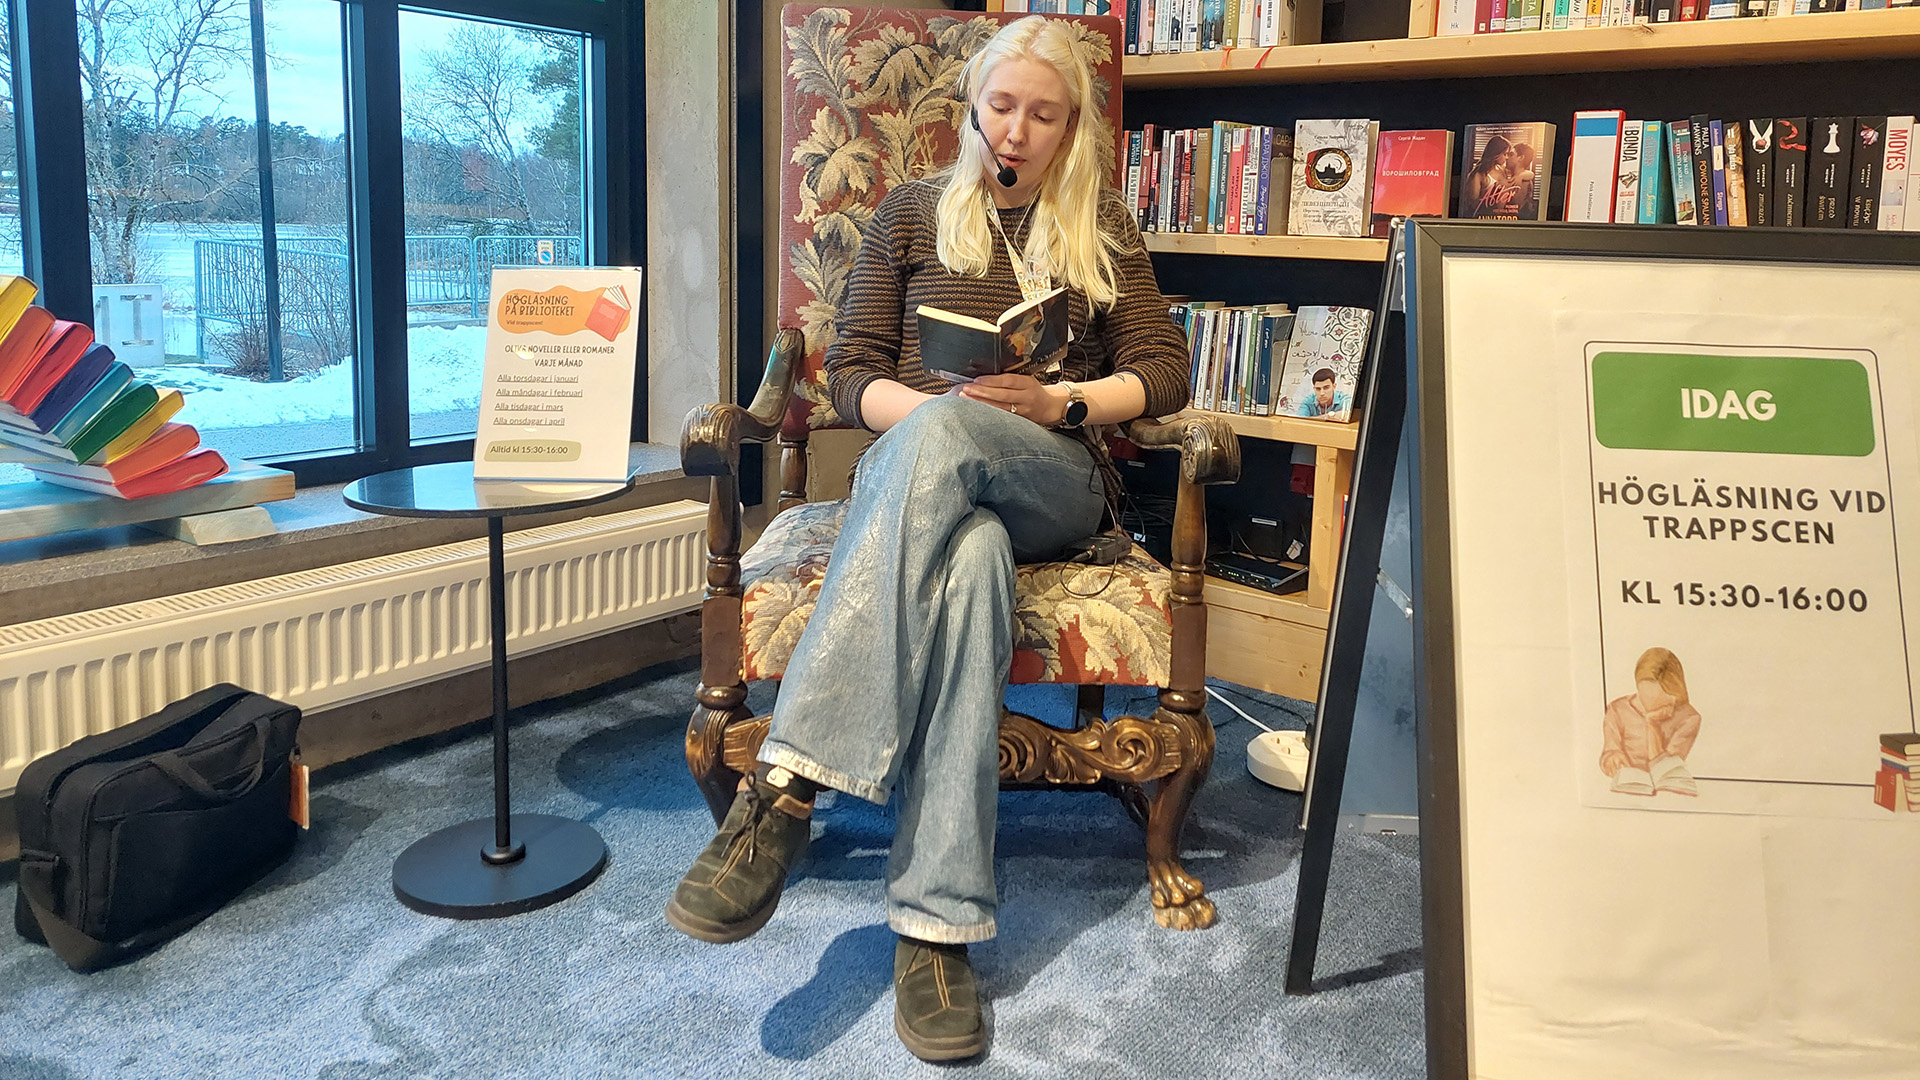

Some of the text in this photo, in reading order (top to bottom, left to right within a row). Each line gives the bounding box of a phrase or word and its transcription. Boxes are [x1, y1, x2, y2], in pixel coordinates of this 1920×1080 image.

[1622, 129, 1639, 162] BONDA
[1693, 122, 1702, 155] HAWKINS
[1886, 129, 1908, 171] MOYES
[1473, 184, 1521, 217] After
[1699, 160, 1710, 225] POWOLNE SPALANI
[505, 292, 569, 306] HÖGLÄSNING
[504, 304, 575, 317] PÅ BIBLIOTEKET
[528, 345, 562, 354] NOVELLER
[562, 345, 581, 354] ELLER
[582, 345, 615, 354] ROMANER
[534, 357, 583, 367] VARJE MÅNAD
[497, 374, 512, 382] Alla
[513, 374, 548, 384] torsdagar
[553, 375, 579, 384] januari
[496, 388, 510, 396] Alla
[513, 388, 548, 398] måndagar
[554, 388, 583, 397] februari
[494, 402, 509, 411] Alla
[511, 403, 540, 412] tisdagar
[1680, 387, 1777, 421] IDAG
[493, 417, 508, 425] Alla
[509, 417, 543, 426] onsdagar
[549, 417, 565, 426] april
[490, 445, 510, 453] Alltid
[521, 446, 568, 454] 15:30-16:00
[1598, 475, 1886, 513] HÖGLÄSNING VID
[1643, 515, 1835, 544] TRAPPSCEN
[1621, 580, 1868, 612] KL 15:30-16:00
